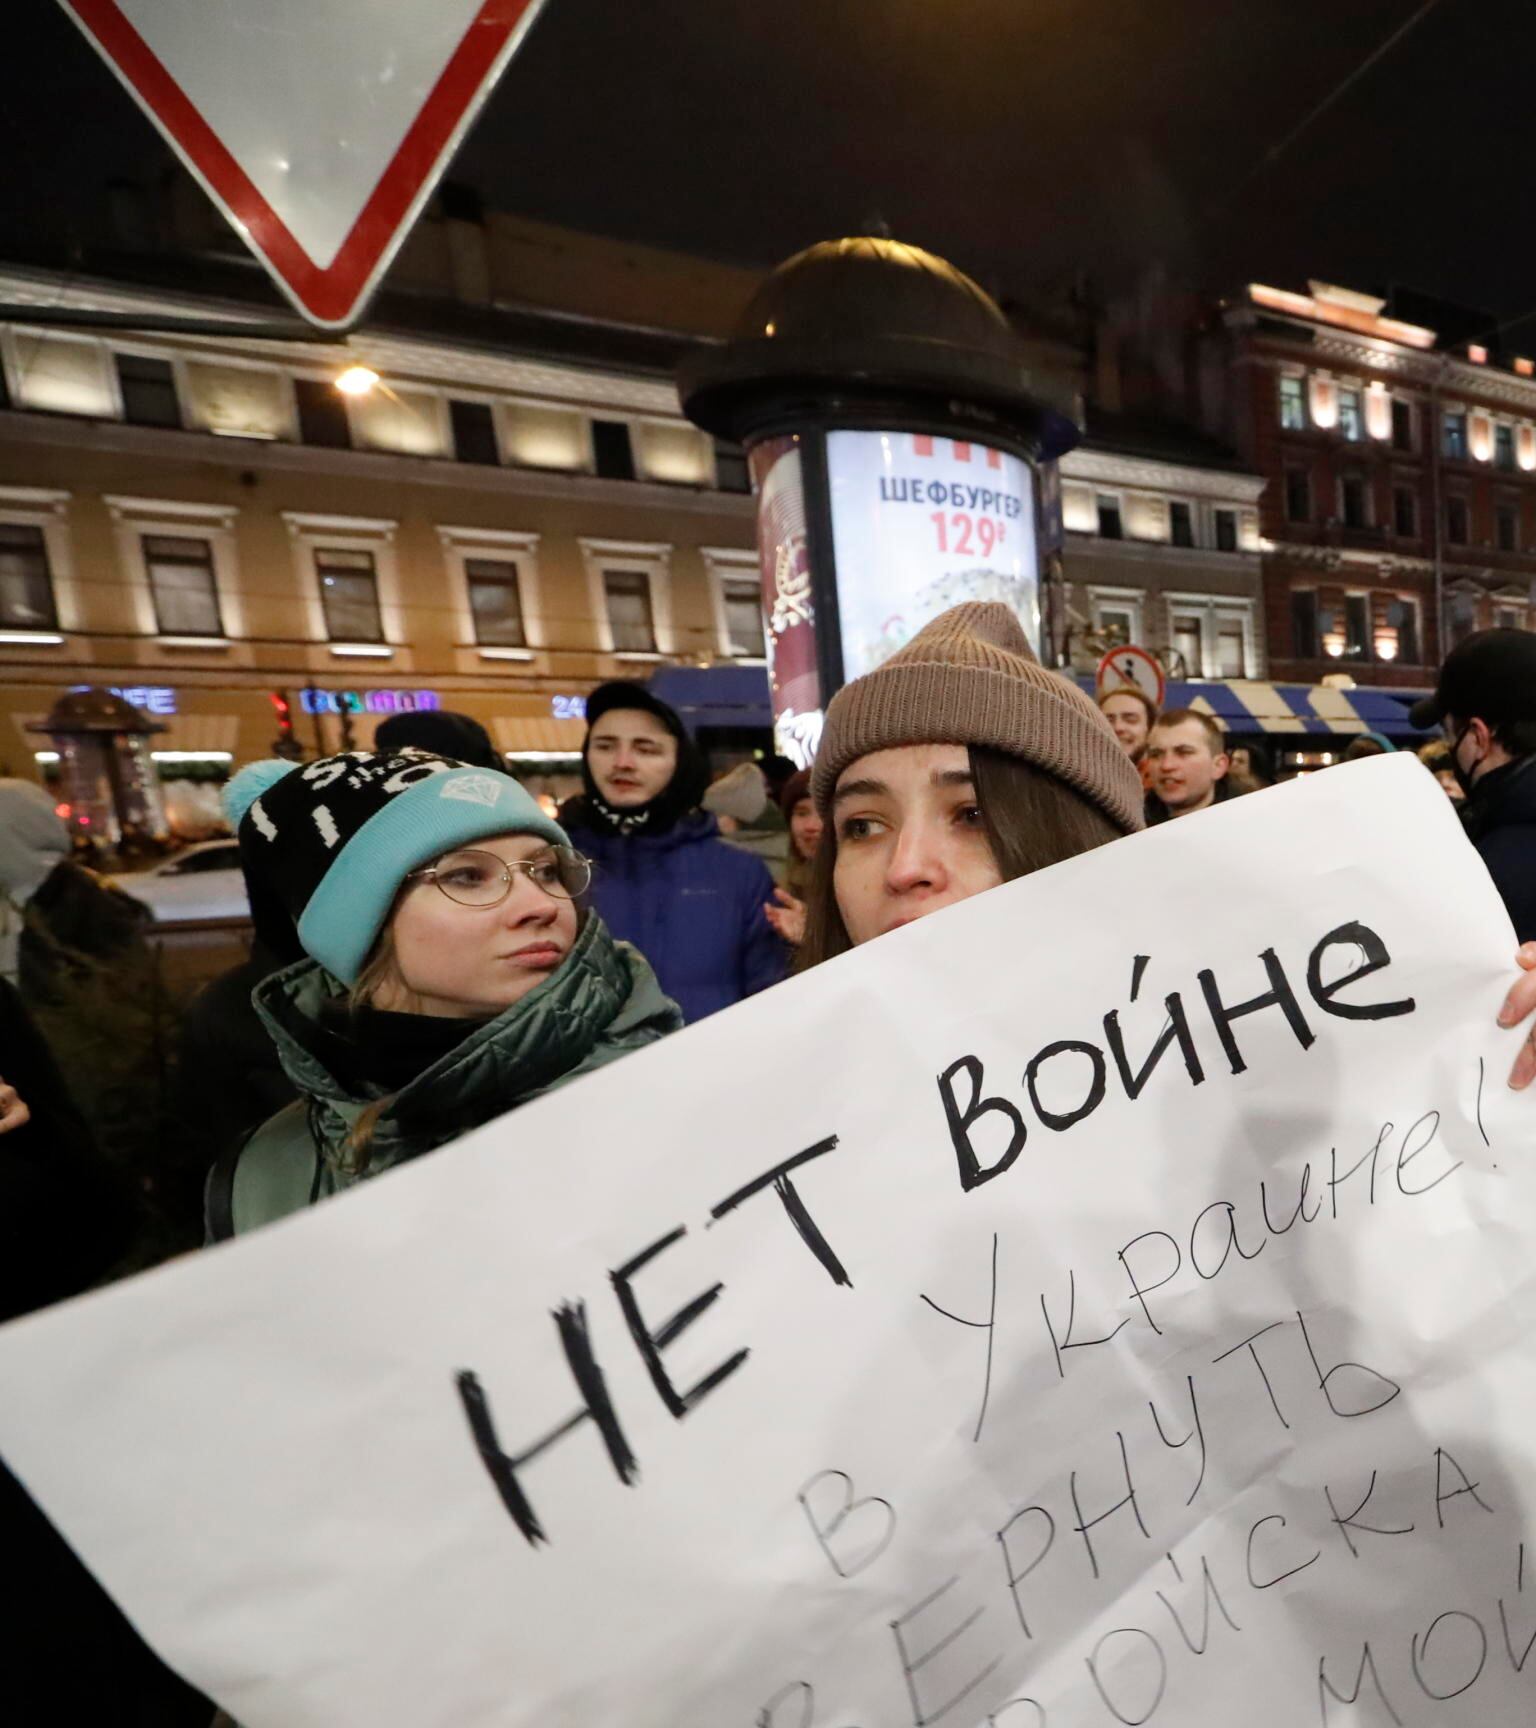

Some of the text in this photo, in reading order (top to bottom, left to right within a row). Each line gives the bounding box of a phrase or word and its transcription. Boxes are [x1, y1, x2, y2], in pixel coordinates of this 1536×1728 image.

[880, 477, 1022, 518] ШЕФБУРГЕР
[453, 1133, 854, 1550] НЕТ
[985, 1446, 1495, 1728] ОЙСКА
